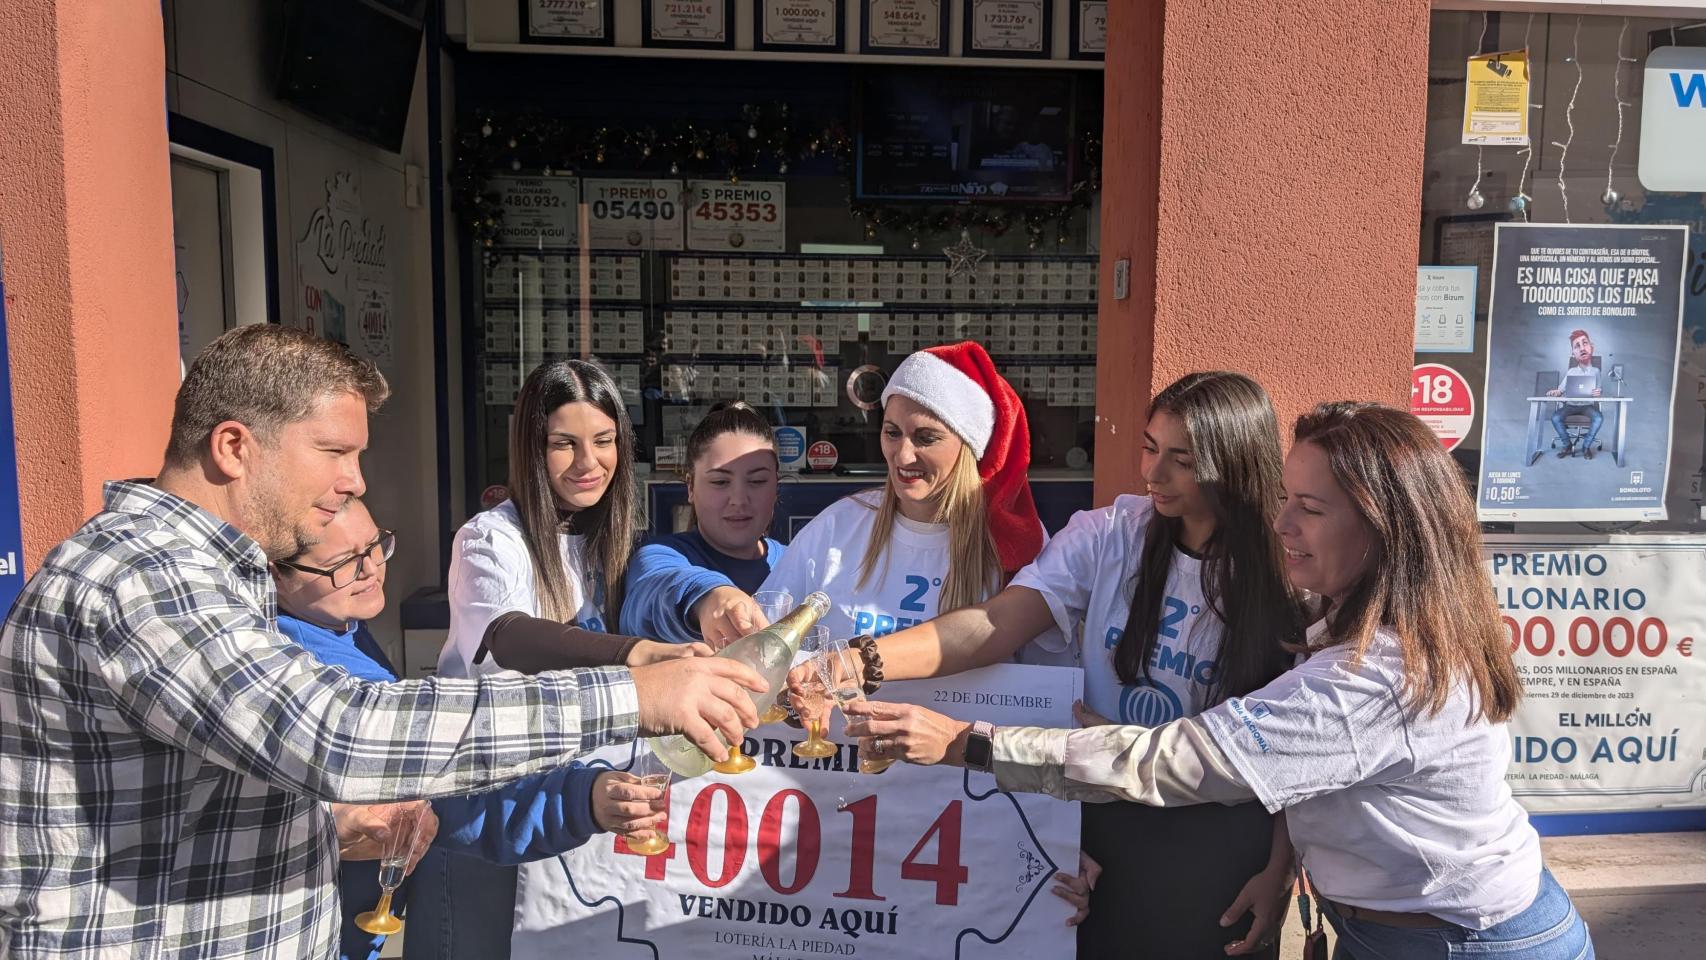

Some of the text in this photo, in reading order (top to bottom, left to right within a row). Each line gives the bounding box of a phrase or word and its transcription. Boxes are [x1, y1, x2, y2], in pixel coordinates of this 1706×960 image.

[610, 188, 668, 199] PREMIO
[715, 189, 772, 201] PREMIO
[593, 201, 675, 220] 05490
[696, 202, 777, 222] 45353
[541, 227, 566, 237] AQUÍ
[1517, 266, 1659, 286] ES UNA COSA QUE PASA
[1444, 293, 1465, 301] Bizum
[1521, 284, 1656, 304] TOOOOODOS LOS DÍAS.
[1538, 306, 1637, 316] COMO EL SORTEO DE BONOLOTO.
[1493, 553, 1607, 576] PREMIO
[855, 611, 923, 638] PRE
[1105, 626, 1220, 685] PEMIO
[1676, 637, 1694, 657] €
[1533, 666, 1553, 674] DOS
[1556, 666, 1623, 675] MILLONARIOS
[1626, 667, 1639, 675] EN
[1642, 665, 1678, 675] ESPAÑA
[1559, 678, 1565, 686] Y
[1567, 678, 1580, 686] EN
[1583, 677, 1622, 687] ESPAÑA
[934, 690, 1053, 709] 22 DE DICIEMBRE
[1572, 691, 1606, 699] diciembre
[1608, 691, 1616, 699] de
[1559, 708, 1651, 727] EL MILLÓN
[1242, 715, 1270, 753] NACIONAL
[740, 737, 888, 774] PREMI
[1591, 729, 1680, 764] AQUÍ
[613, 780, 970, 906] 40014
[679, 893, 898, 939] VENDIDO AQUÍ
[715, 931, 775, 949] LOTERÍA
[780, 937, 797, 950] LA
[802, 939, 856, 956] PIEDAD
